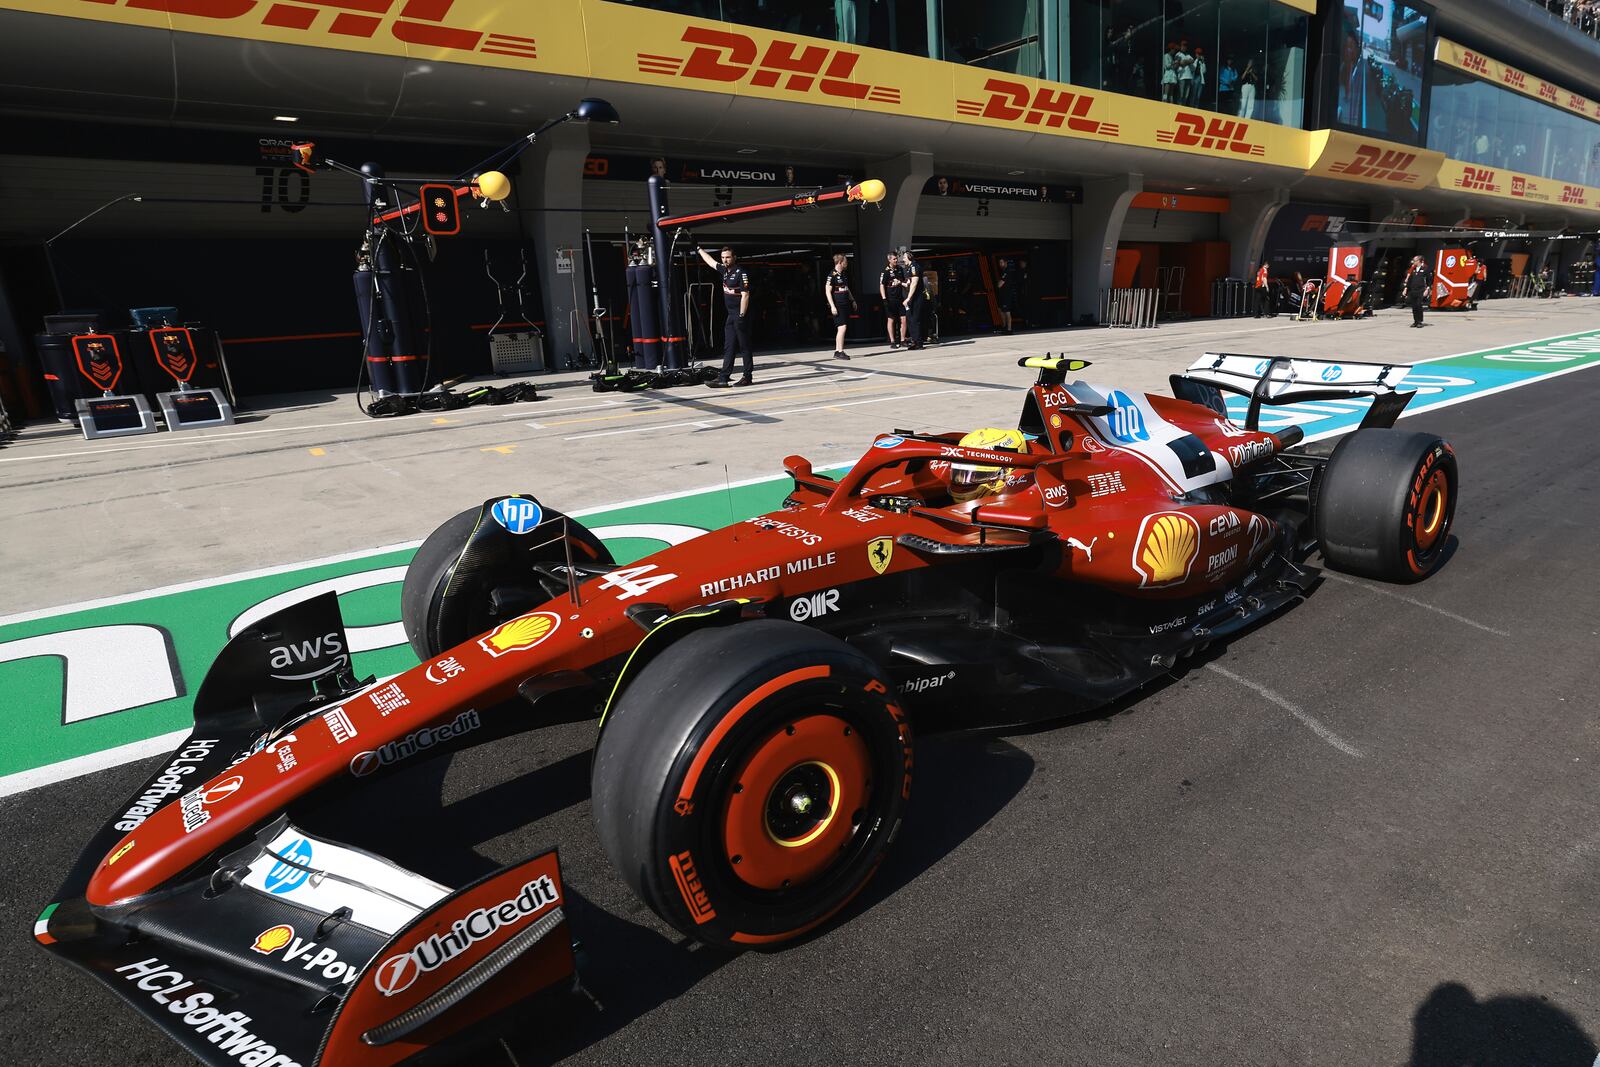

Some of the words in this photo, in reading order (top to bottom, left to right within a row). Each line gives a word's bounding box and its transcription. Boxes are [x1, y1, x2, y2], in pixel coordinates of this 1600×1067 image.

[681, 26, 870, 100] DHL
[1463, 51, 1488, 75] DHL
[1504, 66, 1525, 89] DHL
[982, 78, 1100, 133] DHL
[1539, 82, 1558, 101] DHL
[1173, 112, 1252, 154] DHL
[700, 168, 776, 181] LAWSON
[1342, 144, 1416, 181] DHL
[1462, 166, 1495, 192] DHL
[255, 168, 310, 213] 10
[965, 184, 1038, 196] VERSTAPPEN
[1561, 185, 1585, 204] DHL
[1321, 364, 1343, 382] hp
[1109, 392, 1145, 442] hp
[941, 447, 964, 457] DXC
[966, 451, 1013, 463] TECHNOLOGY
[1239, 437, 1274, 465] UniCredit
[1045, 484, 1069, 500] aws
[1087, 471, 1127, 498] IBM
[500, 498, 537, 534] hp
[1210, 511, 1241, 537] CEVA
[700, 565, 781, 598] RICHARD
[787, 552, 837, 575] MILLE
[1207, 544, 1238, 573] PERONI
[598, 564, 679, 601] 44
[269, 632, 343, 669] aws
[436, 656, 465, 679] aws
[369, 682, 410, 717] IBM
[322, 706, 358, 745] PIRELLI
[378, 708, 480, 768] UniCredit
[277, 744, 298, 772] CELSIUS
[114, 739, 220, 832] HCLSoftware
[266, 840, 312, 894] hp
[668, 850, 717, 925] PIRELLI
[415, 876, 559, 972] UniCredit
